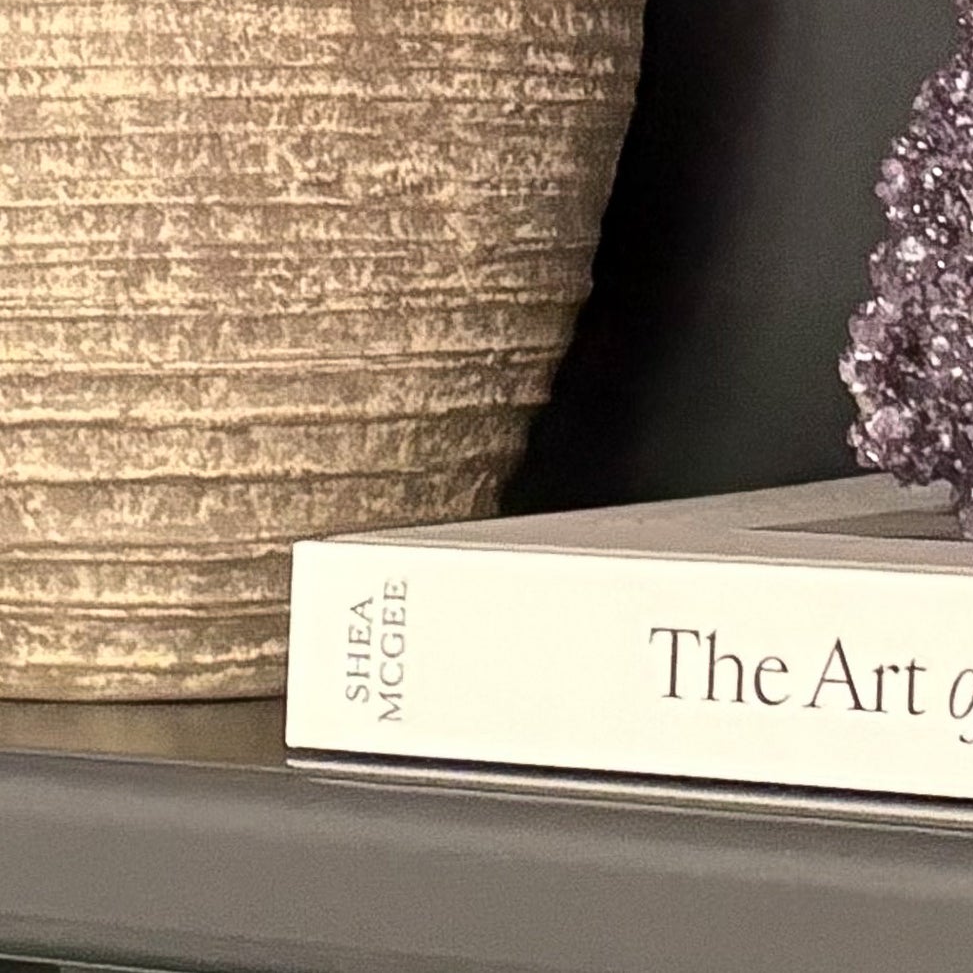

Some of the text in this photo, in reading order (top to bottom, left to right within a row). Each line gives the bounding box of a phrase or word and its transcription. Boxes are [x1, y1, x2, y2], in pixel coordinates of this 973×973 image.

[345, 595, 374, 704] SHEA
[377, 579, 408, 723] MCGEE
[648, 626, 791, 707] The
[801, 636, 928, 717] Art
